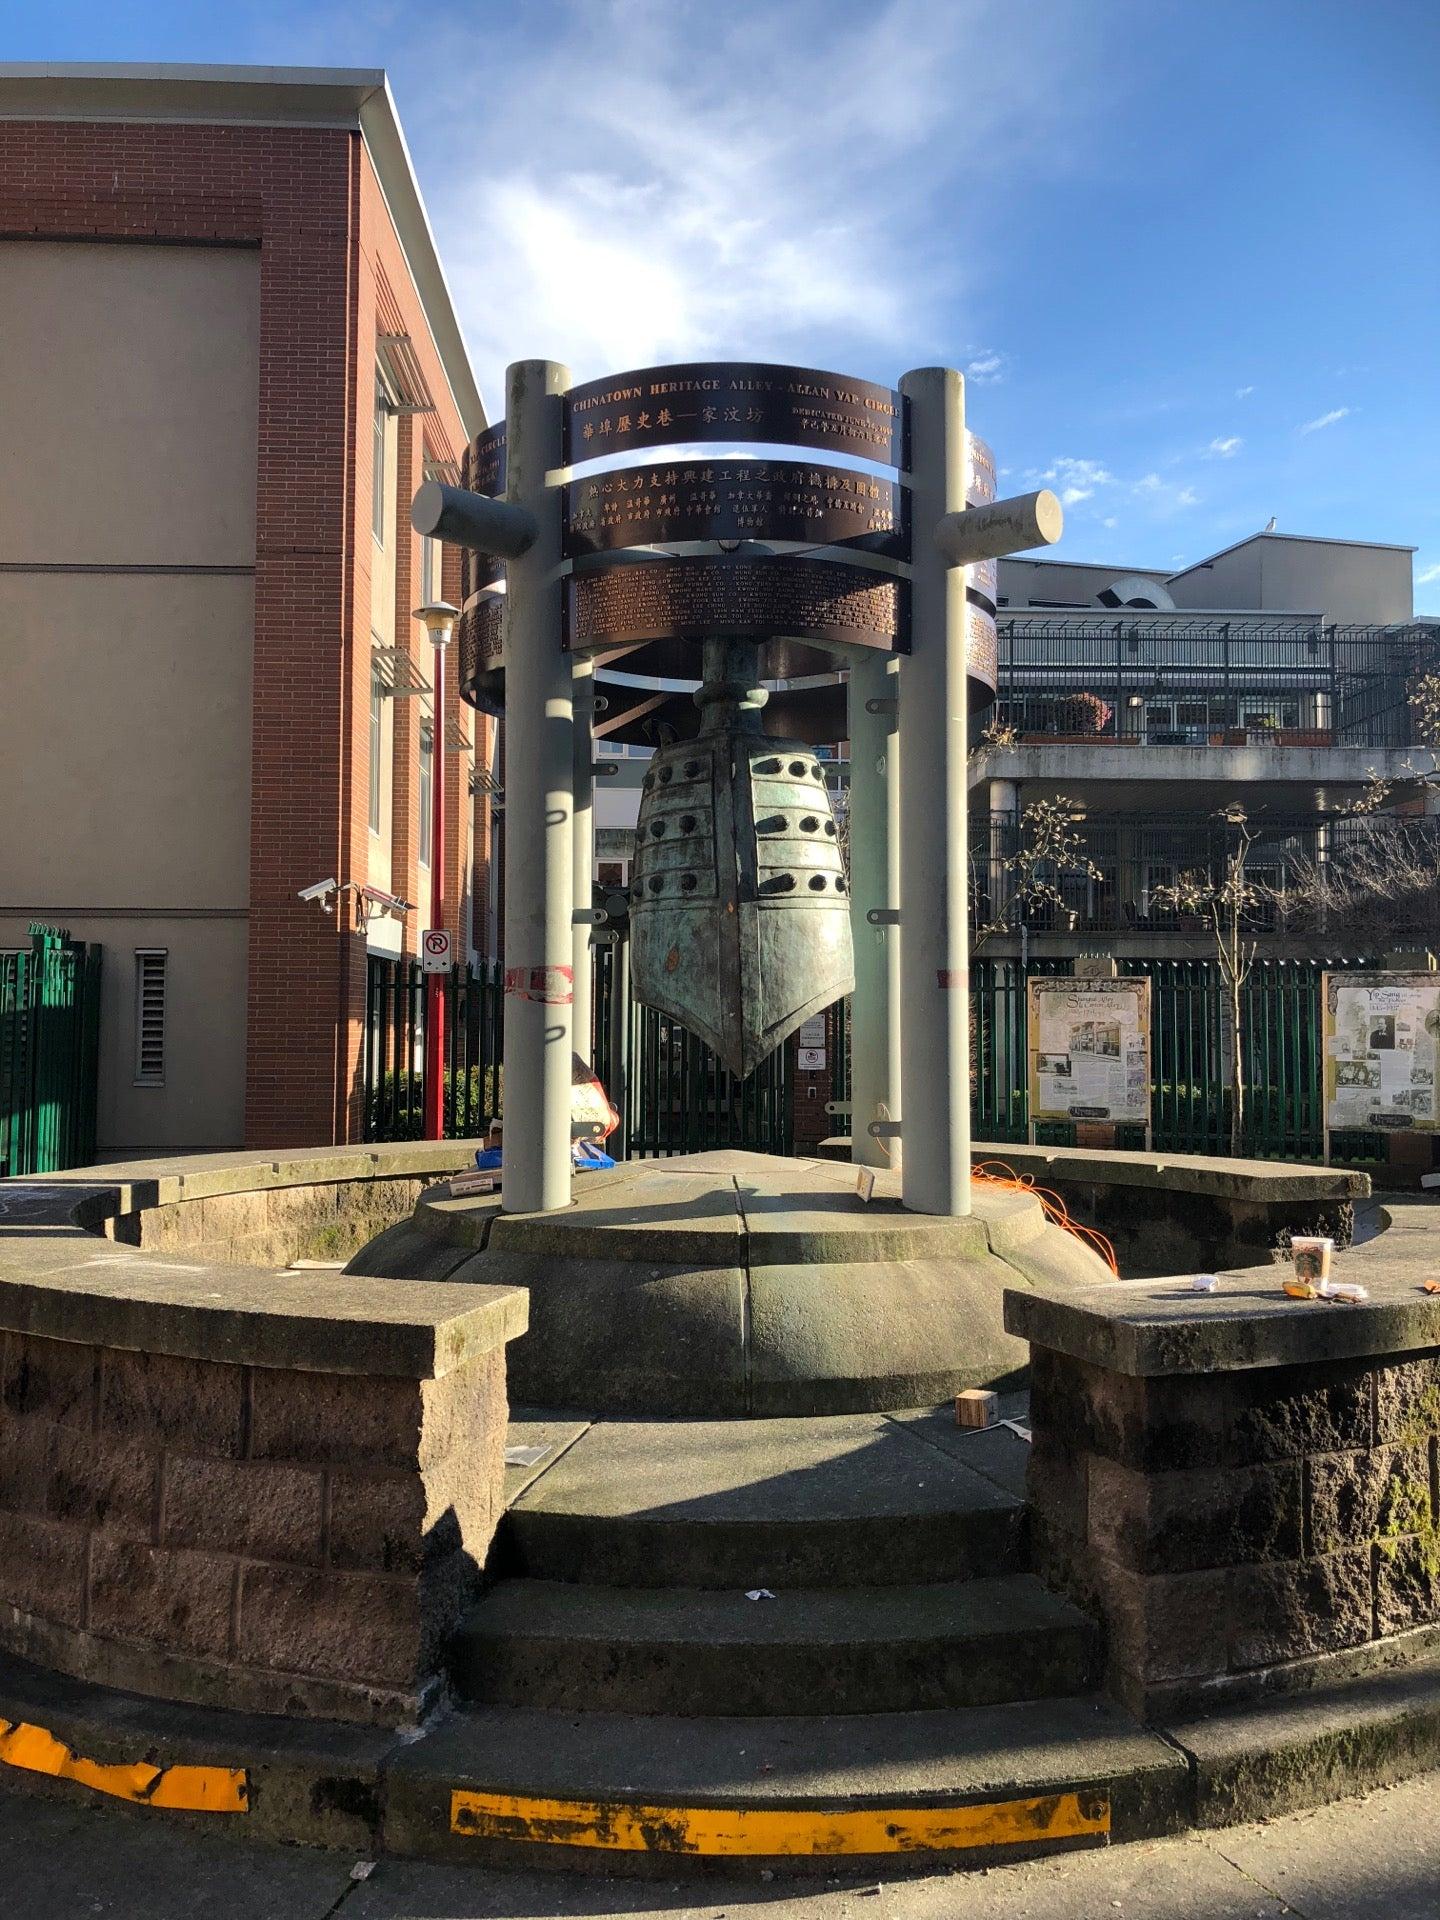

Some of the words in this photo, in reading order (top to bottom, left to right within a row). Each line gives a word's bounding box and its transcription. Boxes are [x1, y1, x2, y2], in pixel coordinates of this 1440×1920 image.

[573, 387, 642, 412] CHINATOWN
[650, 380, 720, 395] HERITAGE
[730, 380, 772, 391] ALLEY
[787, 383, 829, 399] ALLAN
[836, 390, 859, 404] YAP
[864, 398, 900, 417] CIRCLE
